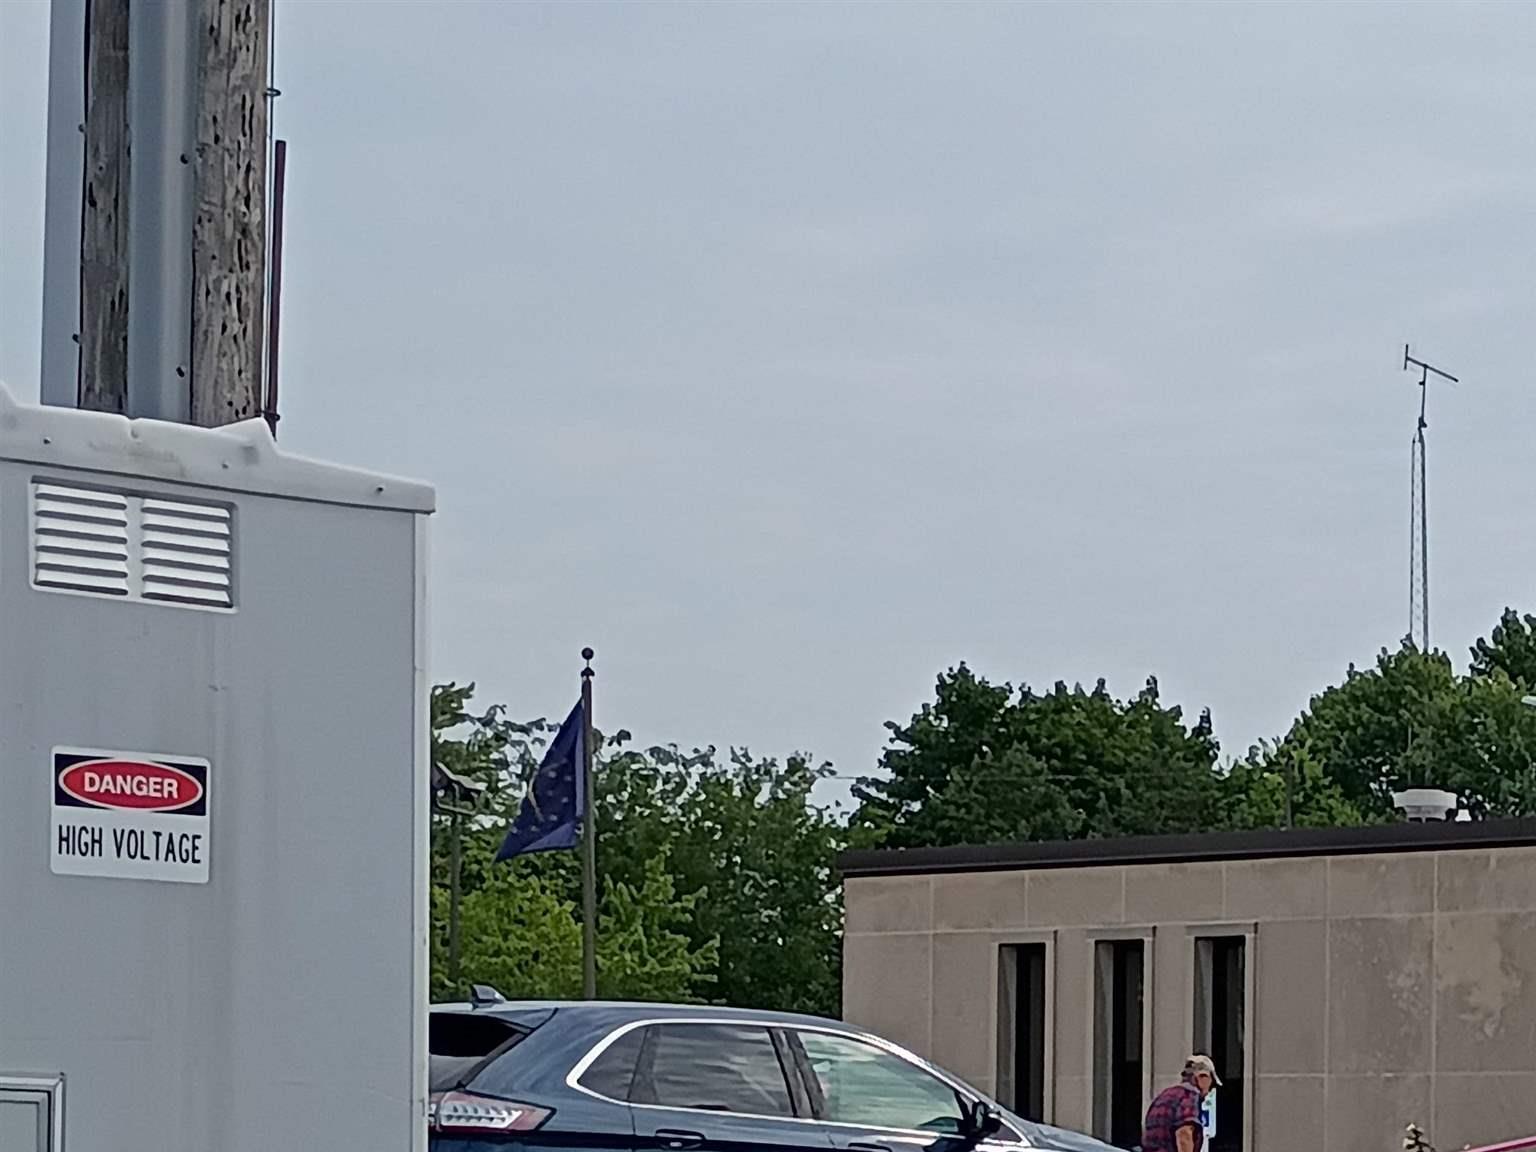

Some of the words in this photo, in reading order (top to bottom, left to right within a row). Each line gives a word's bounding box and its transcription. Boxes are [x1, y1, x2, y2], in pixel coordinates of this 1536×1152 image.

[84, 771, 179, 799] DANGER
[58, 824, 103, 857] HIGH
[113, 828, 202, 864] VOLTAGE
